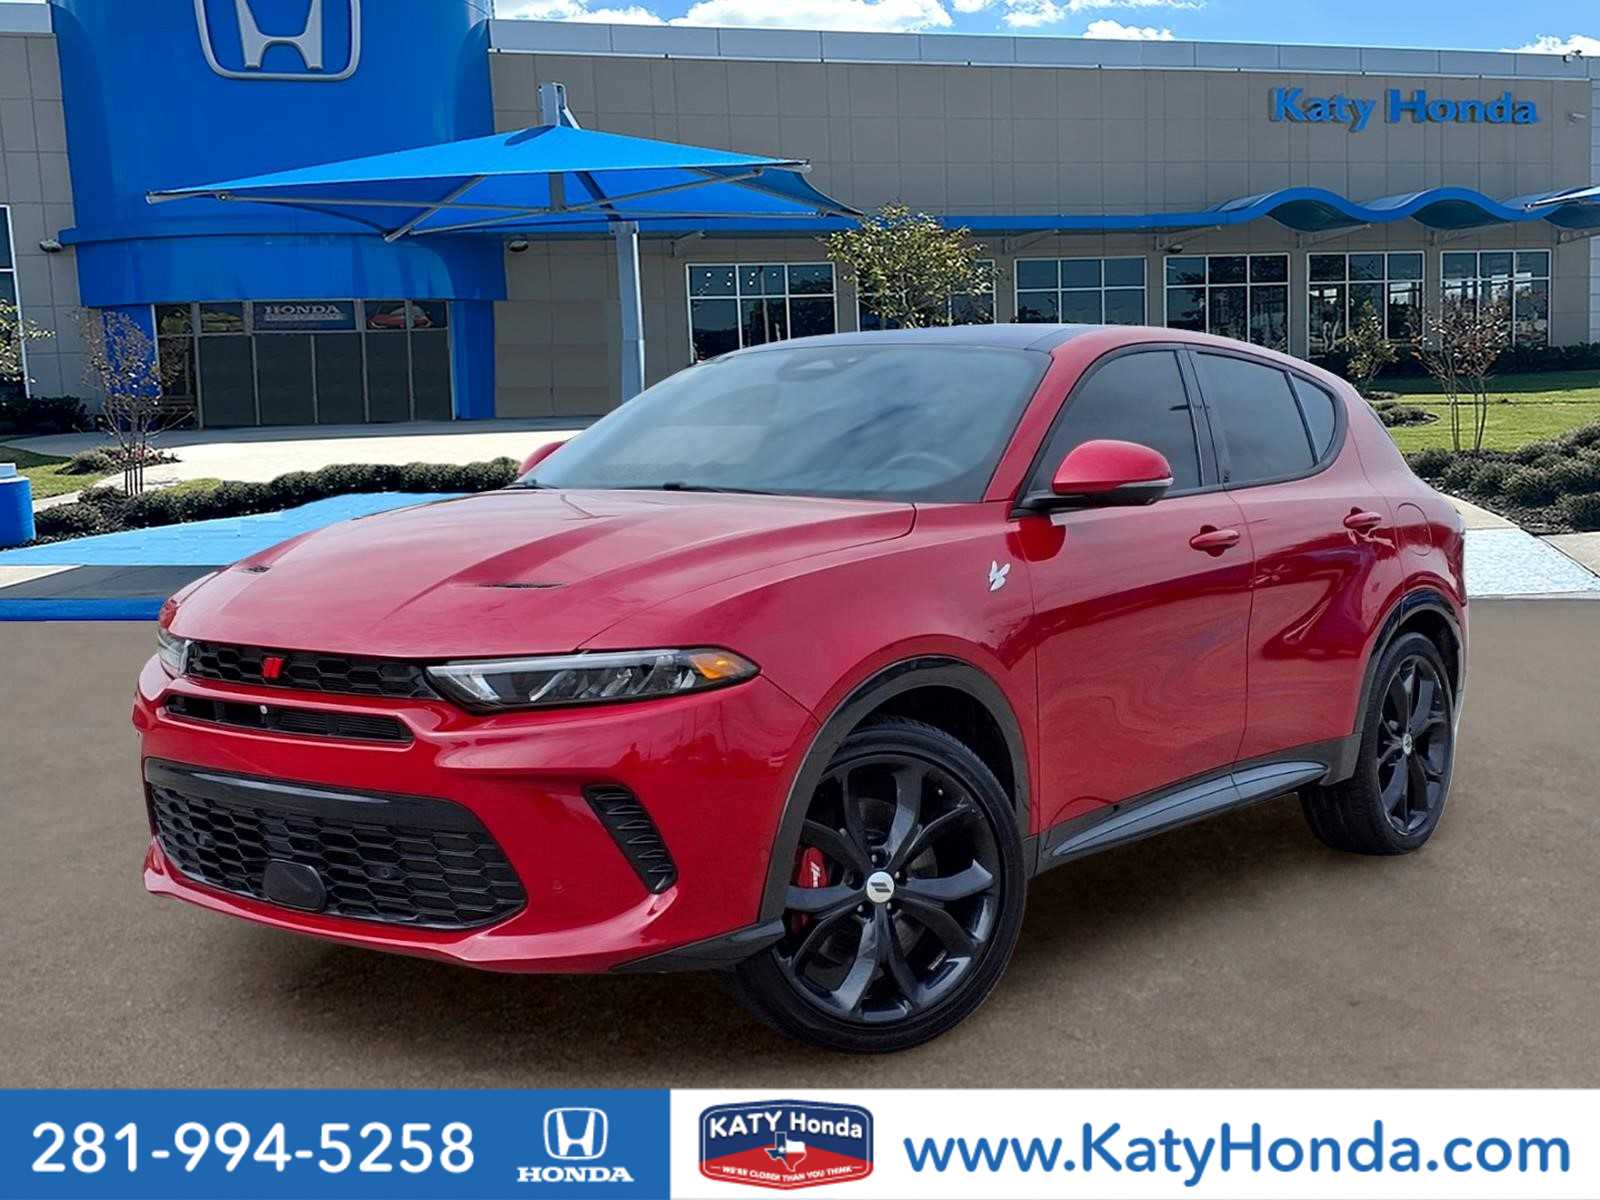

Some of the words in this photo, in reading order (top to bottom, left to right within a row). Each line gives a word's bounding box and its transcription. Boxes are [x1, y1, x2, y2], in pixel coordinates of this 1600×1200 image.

[1269, 87, 1376, 133] Katy
[1385, 88, 1539, 125] Honda
[264, 304, 341, 314] HONDA
